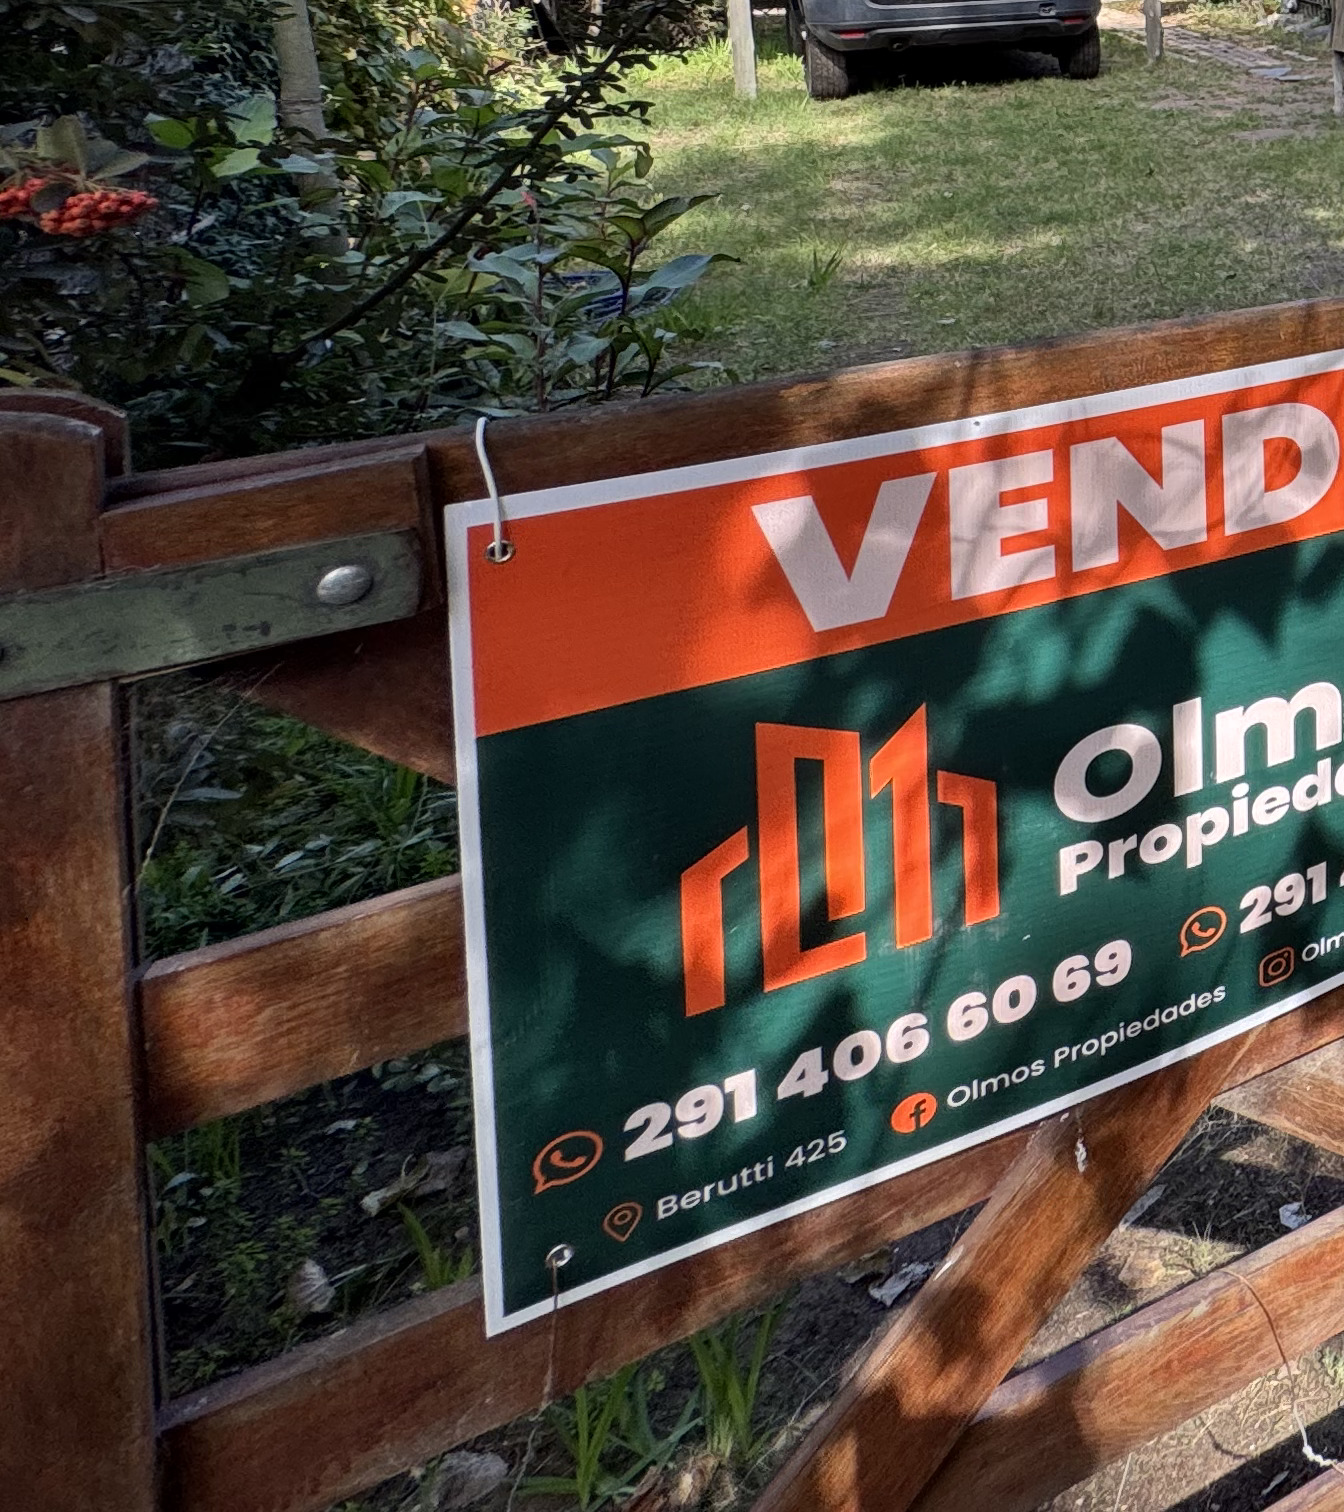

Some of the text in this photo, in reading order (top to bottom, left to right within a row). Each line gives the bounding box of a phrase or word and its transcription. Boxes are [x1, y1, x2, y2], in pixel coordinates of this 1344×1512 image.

[1239, 861, 1328, 935] 291
[623, 938, 1133, 1162] 291 406 60 69
[946, 984, 1227, 1110] Olmos Propiedades
[656, 1129, 848, 1222] Berutti 425
